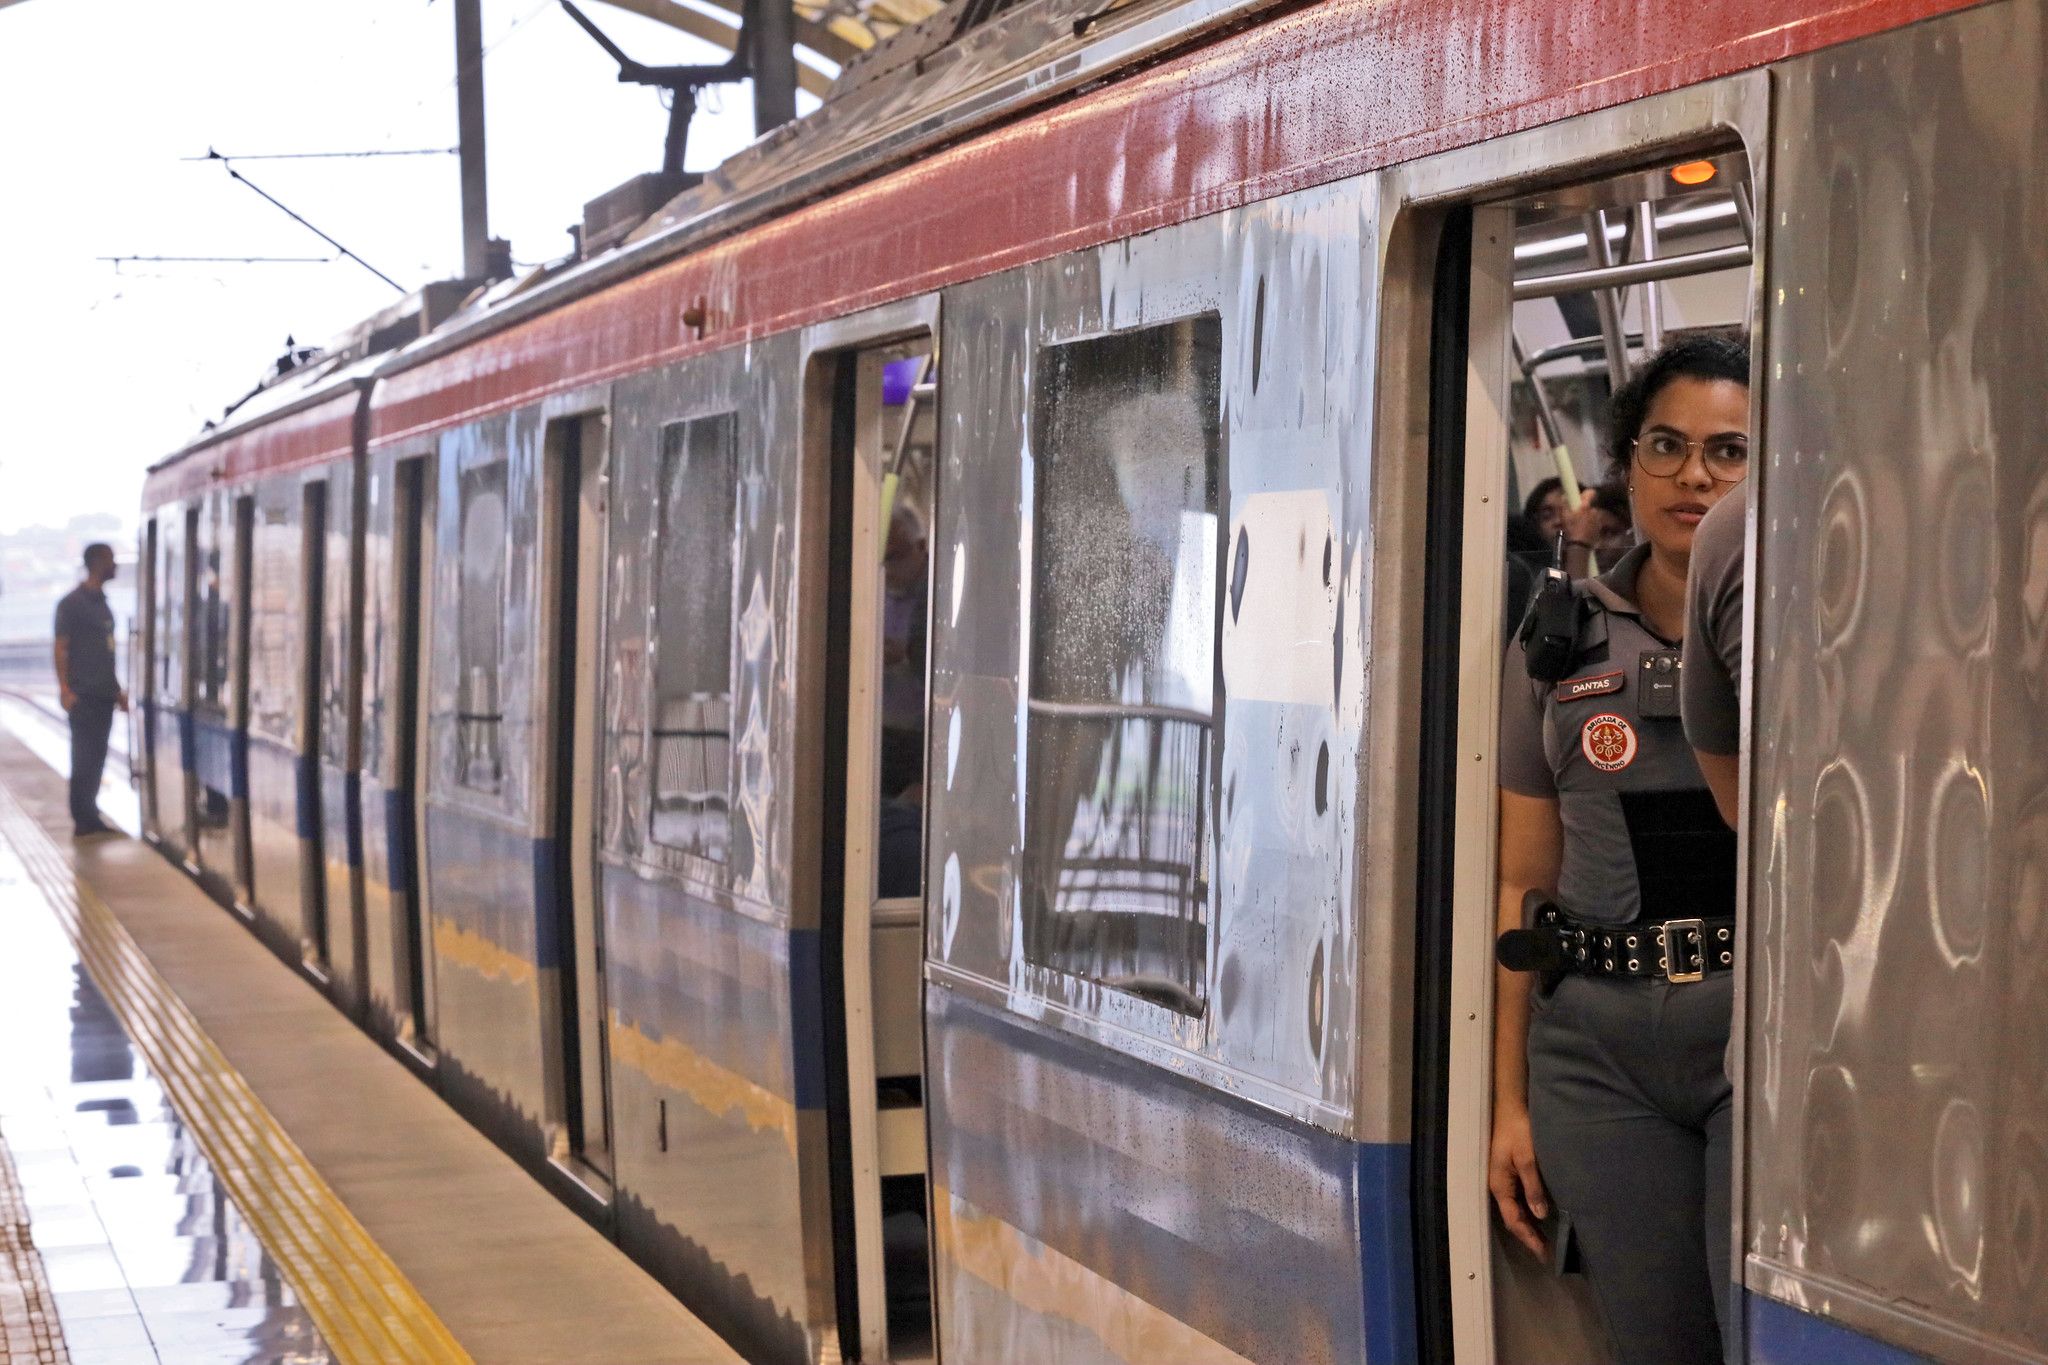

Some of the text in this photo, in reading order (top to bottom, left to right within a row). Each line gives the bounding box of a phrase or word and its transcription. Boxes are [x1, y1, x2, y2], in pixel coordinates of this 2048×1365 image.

[1572, 679, 1610, 693] DANTAS
[1587, 716, 1627, 731] BRIGADA DE
[1594, 760, 1625, 770] INCÊNDIO
